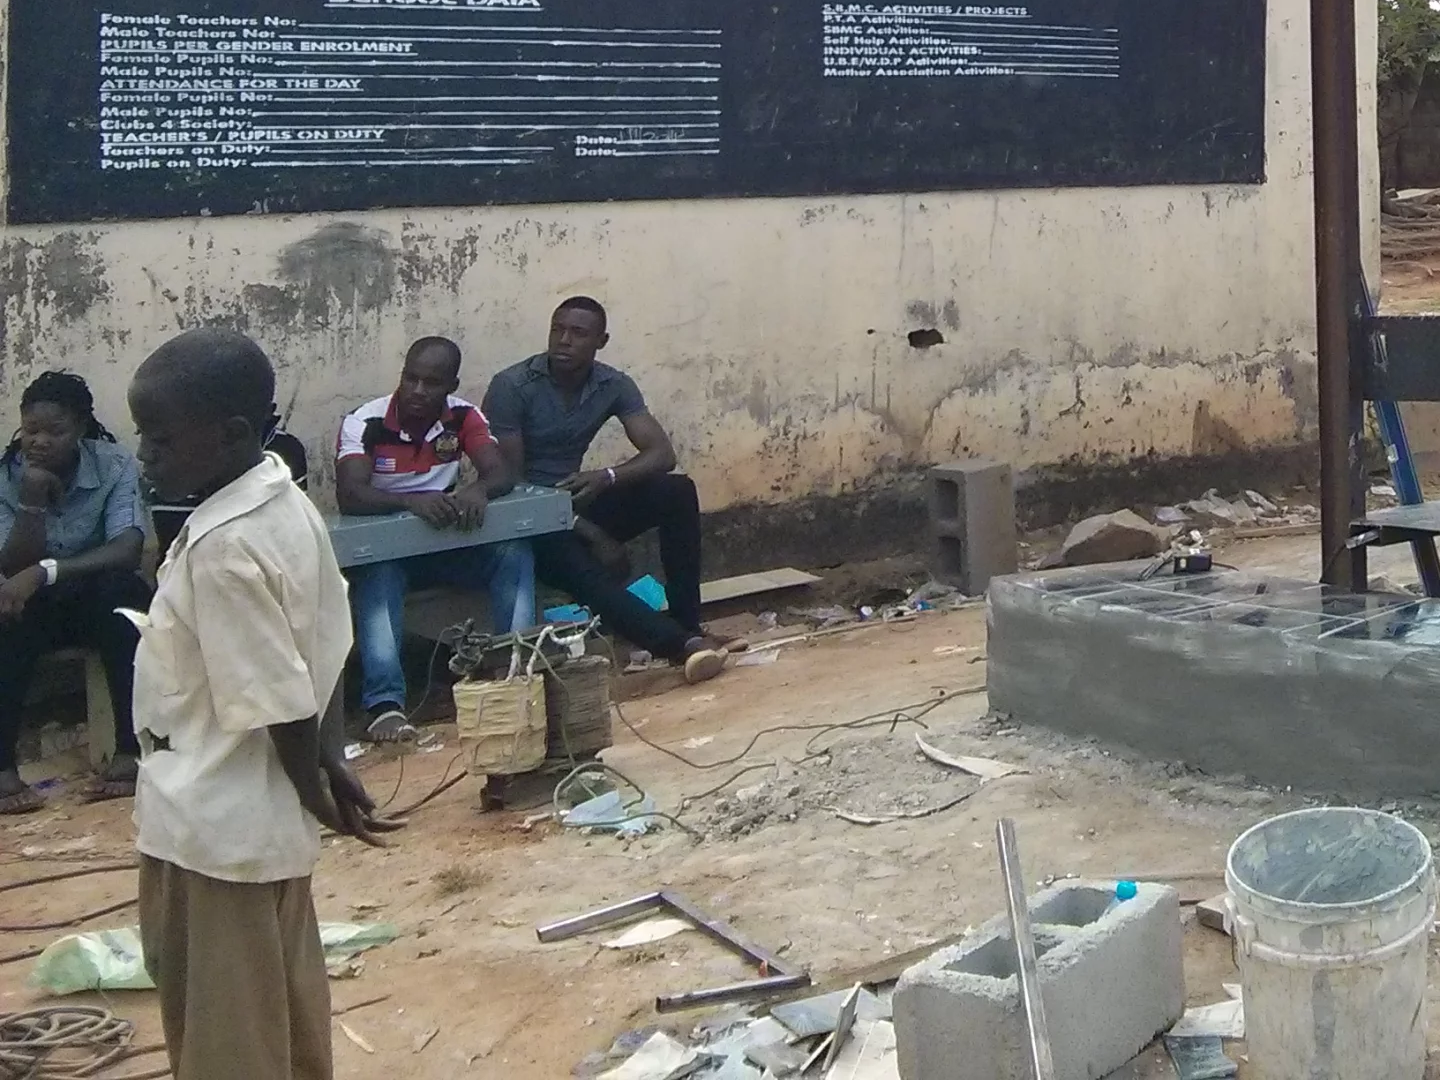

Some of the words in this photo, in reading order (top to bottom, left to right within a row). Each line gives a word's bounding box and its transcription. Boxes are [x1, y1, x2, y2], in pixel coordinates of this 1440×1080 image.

[823, 4, 878, 13] S.B.M.C.
[882, 5, 952, 14] ACTIVITIES
[965, 6, 1028, 15] PROJECTS
[100, 13, 171, 24] Female
[177, 14, 258, 26] Teachers
[264, 16, 296, 26] No:
[824, 15, 856, 24] P.T.A
[861, 15, 925, 24] Activities:
[100, 26, 149, 37] Male
[155, 27, 237, 38] Teachers
[242, 28, 275, 38] No:
[824, 25, 862, 34] SBMC
[866, 25, 930, 35] Activities:
[100, 40, 168, 50] PUPILS
[173, 40, 209, 50] PER
[215, 41, 294, 51] GENDER
[300, 40, 413, 52] ENROLMENT
[824, 36, 849, 45] Self
[853, 36, 885, 46] Help
[888, 36, 951, 45] Activities:
[824, 47, 906, 55] INDIVIDUAL
[909, 46, 982, 56] ACTIVITIES:
[100, 53, 171, 63] Female
[176, 54, 234, 65] Pupils
[241, 54, 273, 63] No:
[100, 66, 149, 76] Male
[155, 67, 213, 78] Pupils
[219, 67, 252, 76] No:
[824, 68, 872, 77] Mother
[875, 67, 950, 77] Association
[954, 66, 1015, 76] Activities:
[100, 79, 233, 89] ATTENDANCE
[239, 79, 278, 89] FOR
[284, 79, 319, 89] THE
[324, 78, 361, 89] DAY
[100, 92, 171, 102] Female
[177, 92, 234, 104] Pupils
[240, 92, 273, 102] No:
[100, 107, 149, 117] Male
[155, 106, 213, 118] Pupils
[219, 106, 252, 116] No:
[100, 120, 155, 130] Clubs
[180, 119, 252, 130] Society:
[100, 131, 208, 142] TEACHER'S
[228, 130, 292, 141] PUPILS
[297, 129, 329, 139] ON
[334, 128, 385, 139] DUTY
[576, 135, 617, 144] Date:
[100, 144, 184, 156] Teachers
[191, 146, 214, 155] on
[221, 144, 270, 155] Duty:
[575, 147, 617, 156] Date:
[100, 159, 160, 170] Pupils
[166, 159, 190, 168] on
[197, 157, 247, 168] Duty:
